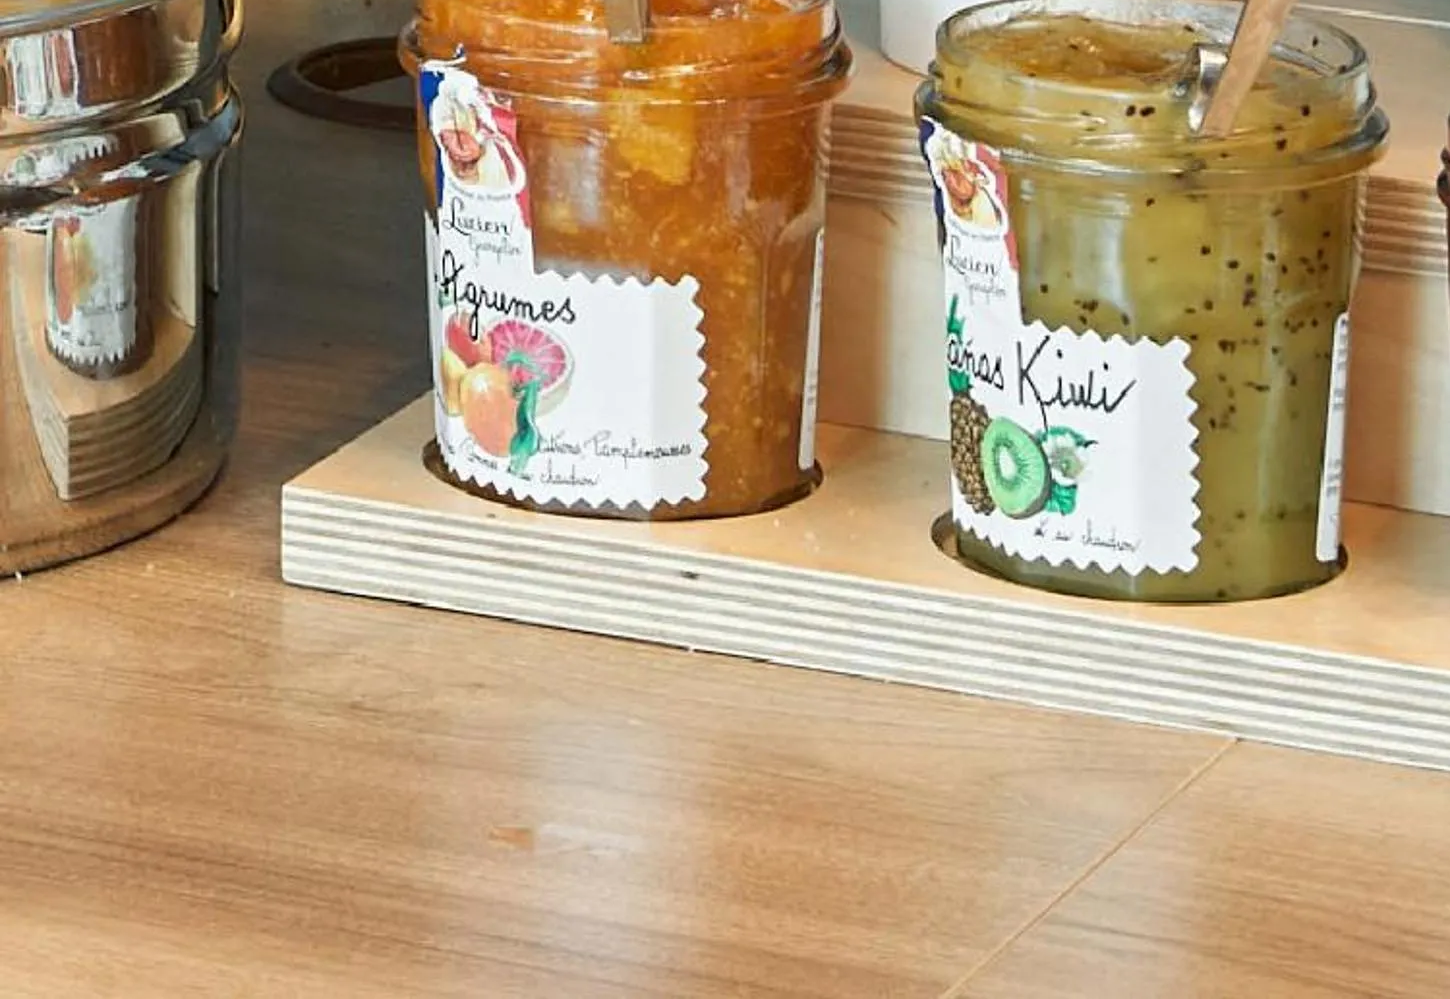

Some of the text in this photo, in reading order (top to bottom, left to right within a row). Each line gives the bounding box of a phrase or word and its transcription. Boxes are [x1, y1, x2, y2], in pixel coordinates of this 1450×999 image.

[442, 196, 511, 237] Lucien
[435, 250, 577, 341] Agrumes
[1016, 334, 1137, 428] Kiwi
